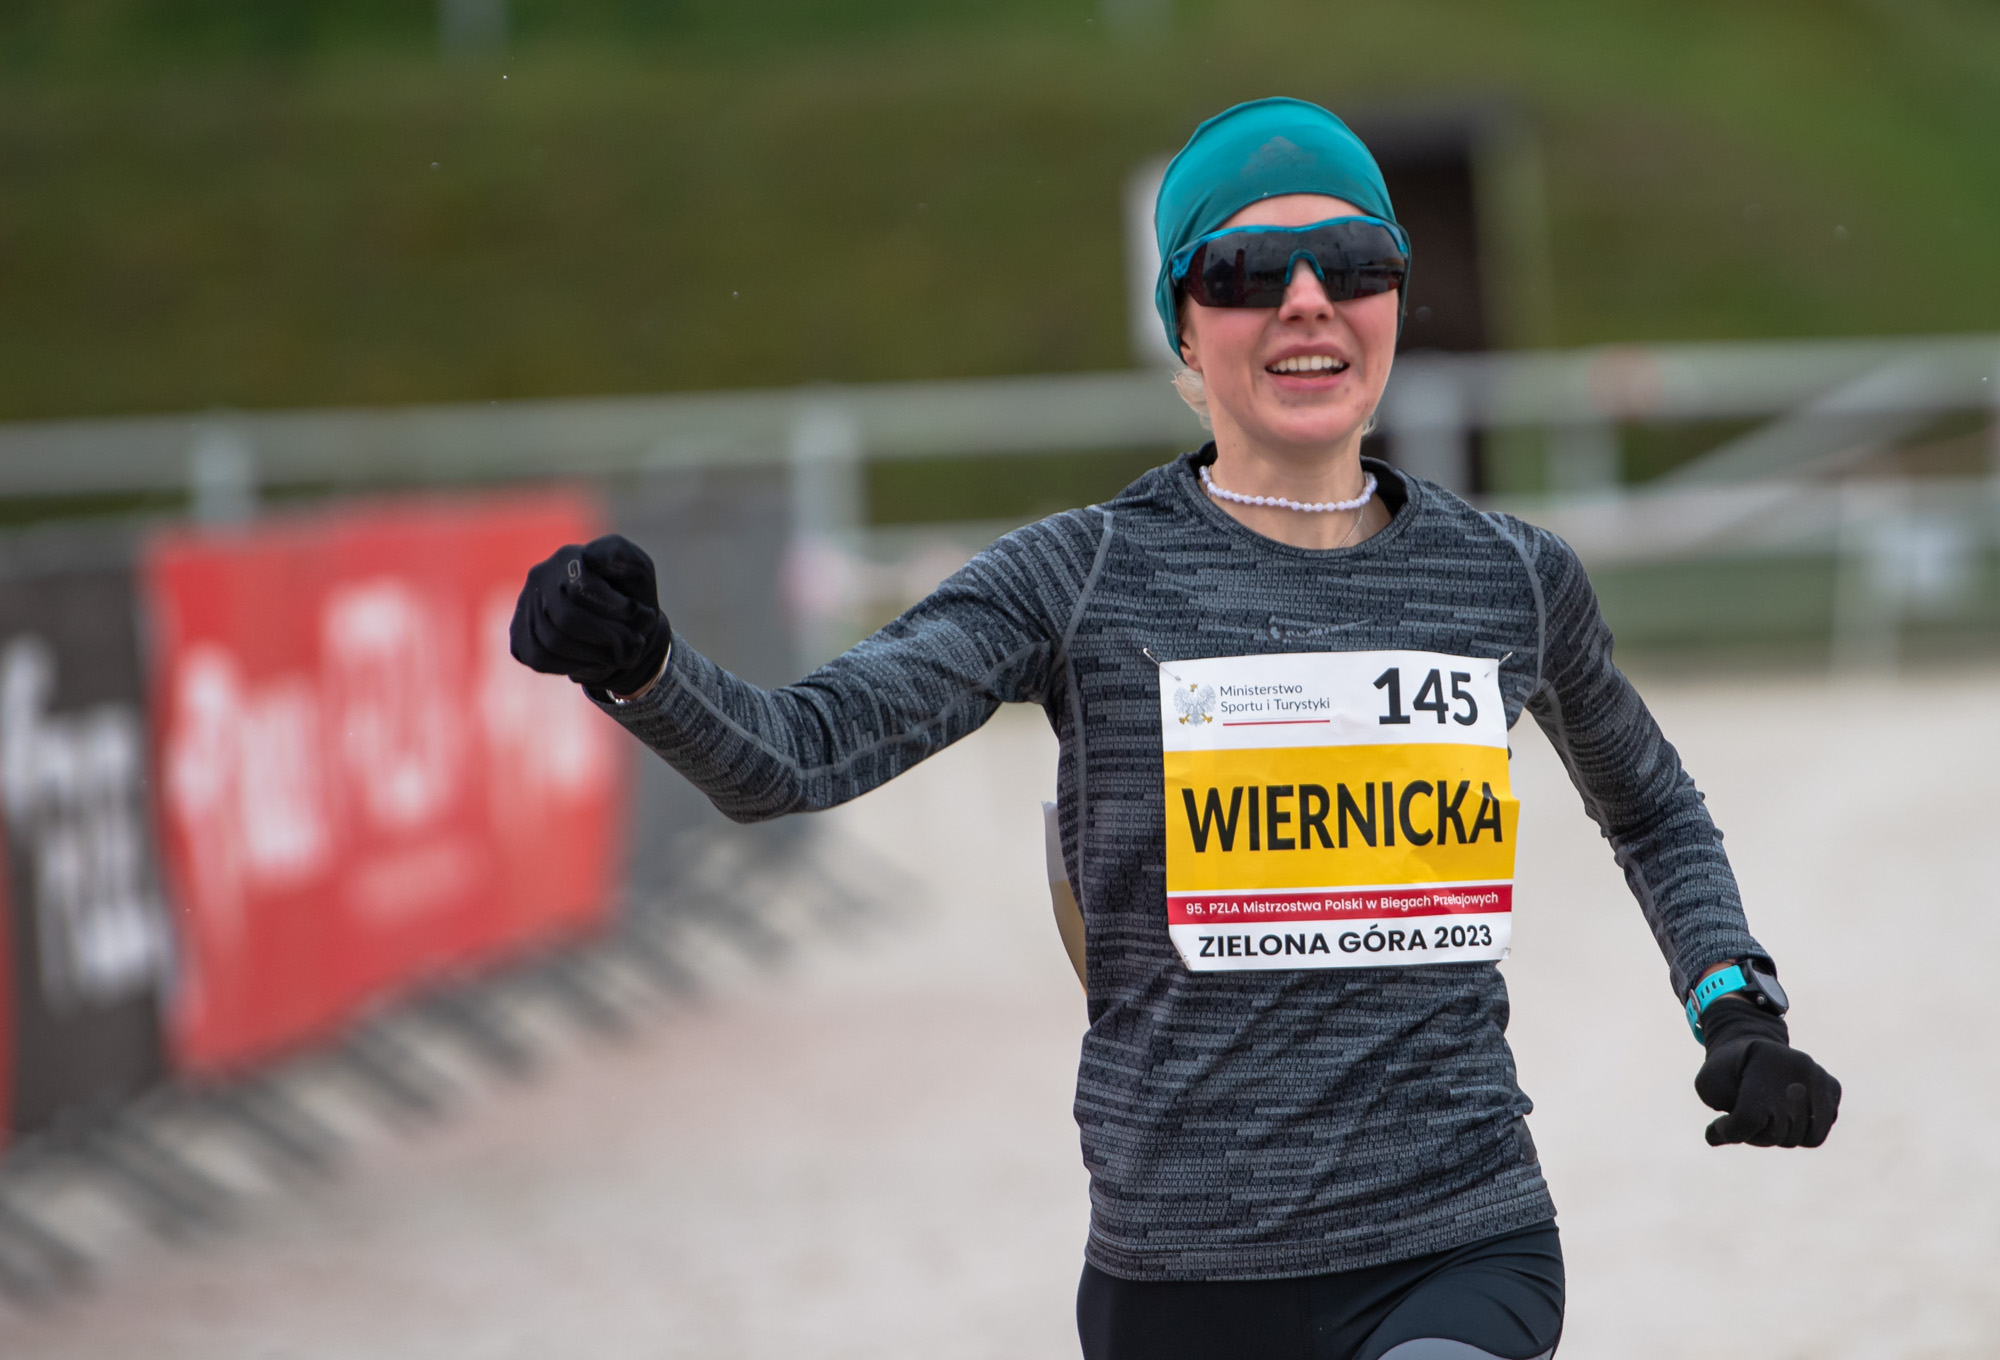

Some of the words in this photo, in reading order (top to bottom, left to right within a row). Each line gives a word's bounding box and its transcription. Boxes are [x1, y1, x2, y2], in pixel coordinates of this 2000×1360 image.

[1219, 683, 1303, 697] Ministerstwo
[1372, 666, 1479, 726] 145
[1220, 700, 1263, 714] Sportu
[1266, 699, 1271, 711] i
[1273, 697, 1331, 712] Turystyki
[1181, 779, 1503, 854] WIERNICKA
[1185, 902, 1206, 915] 95.
[1209, 902, 1240, 915] PZLA
[1243, 900, 1322, 913] Mistrzostwa
[1325, 898, 1363, 911] Polski
[1365, 899, 1378, 910] w
[1380, 895, 1431, 912] Biegach
[1198, 932, 1331, 958] ZIELONA
[1338, 923, 1428, 954] GÓRA
[1434, 924, 1493, 949] 2023
